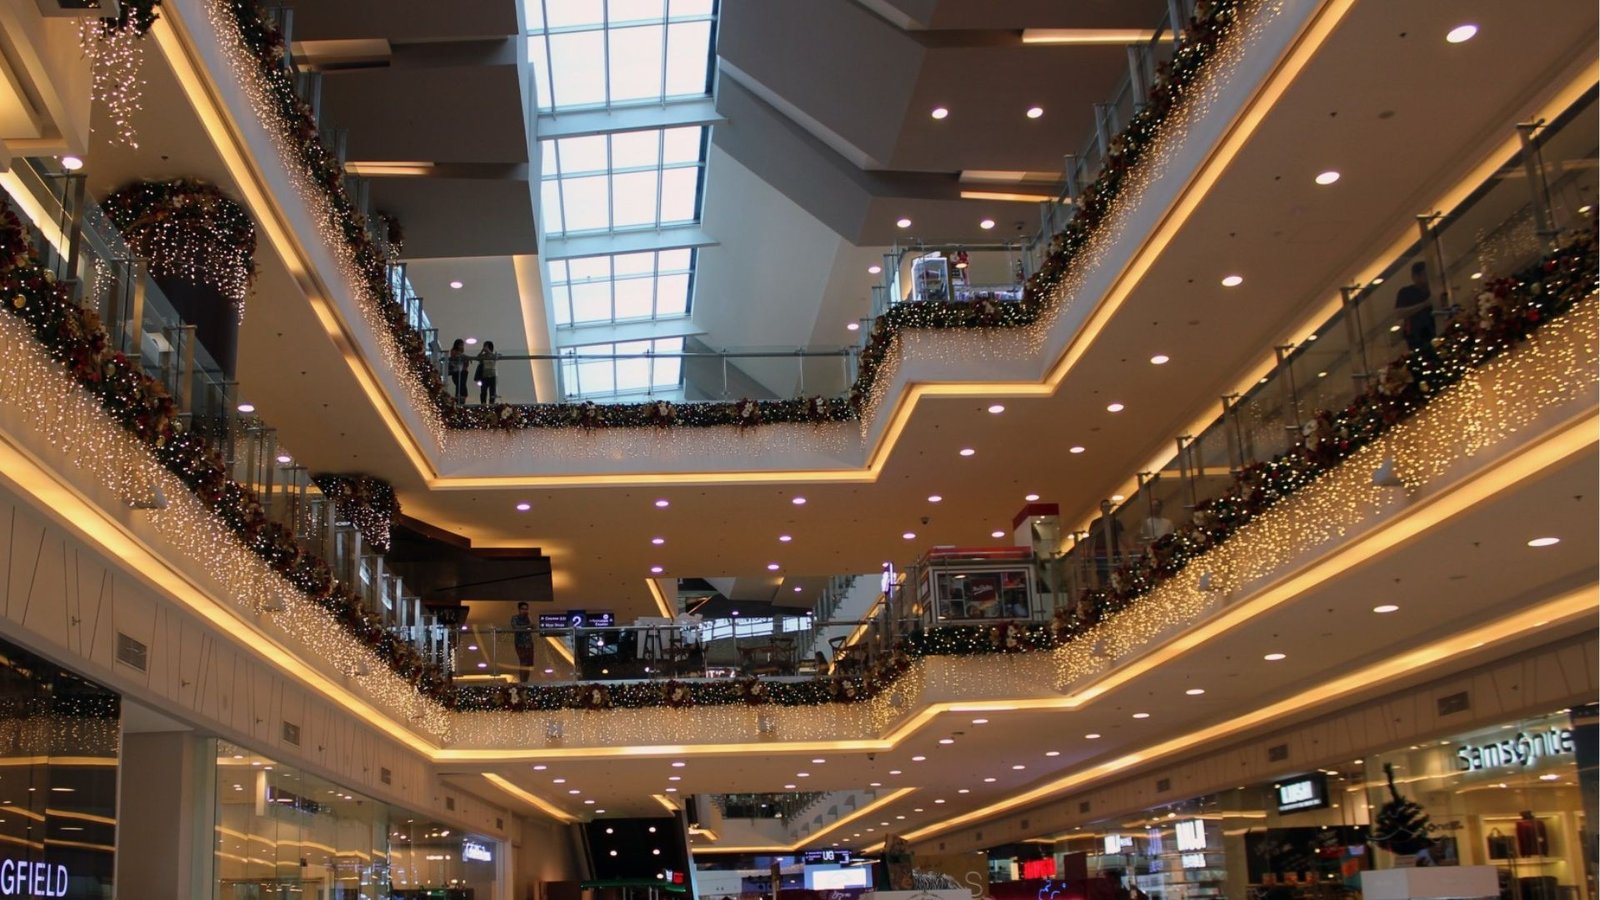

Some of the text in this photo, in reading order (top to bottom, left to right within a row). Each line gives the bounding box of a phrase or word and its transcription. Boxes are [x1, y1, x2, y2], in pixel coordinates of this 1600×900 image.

[572, 615, 582, 628] 2
[1457, 727, 1576, 771] Samsonite
[1, 859, 68, 897] GFIELD
